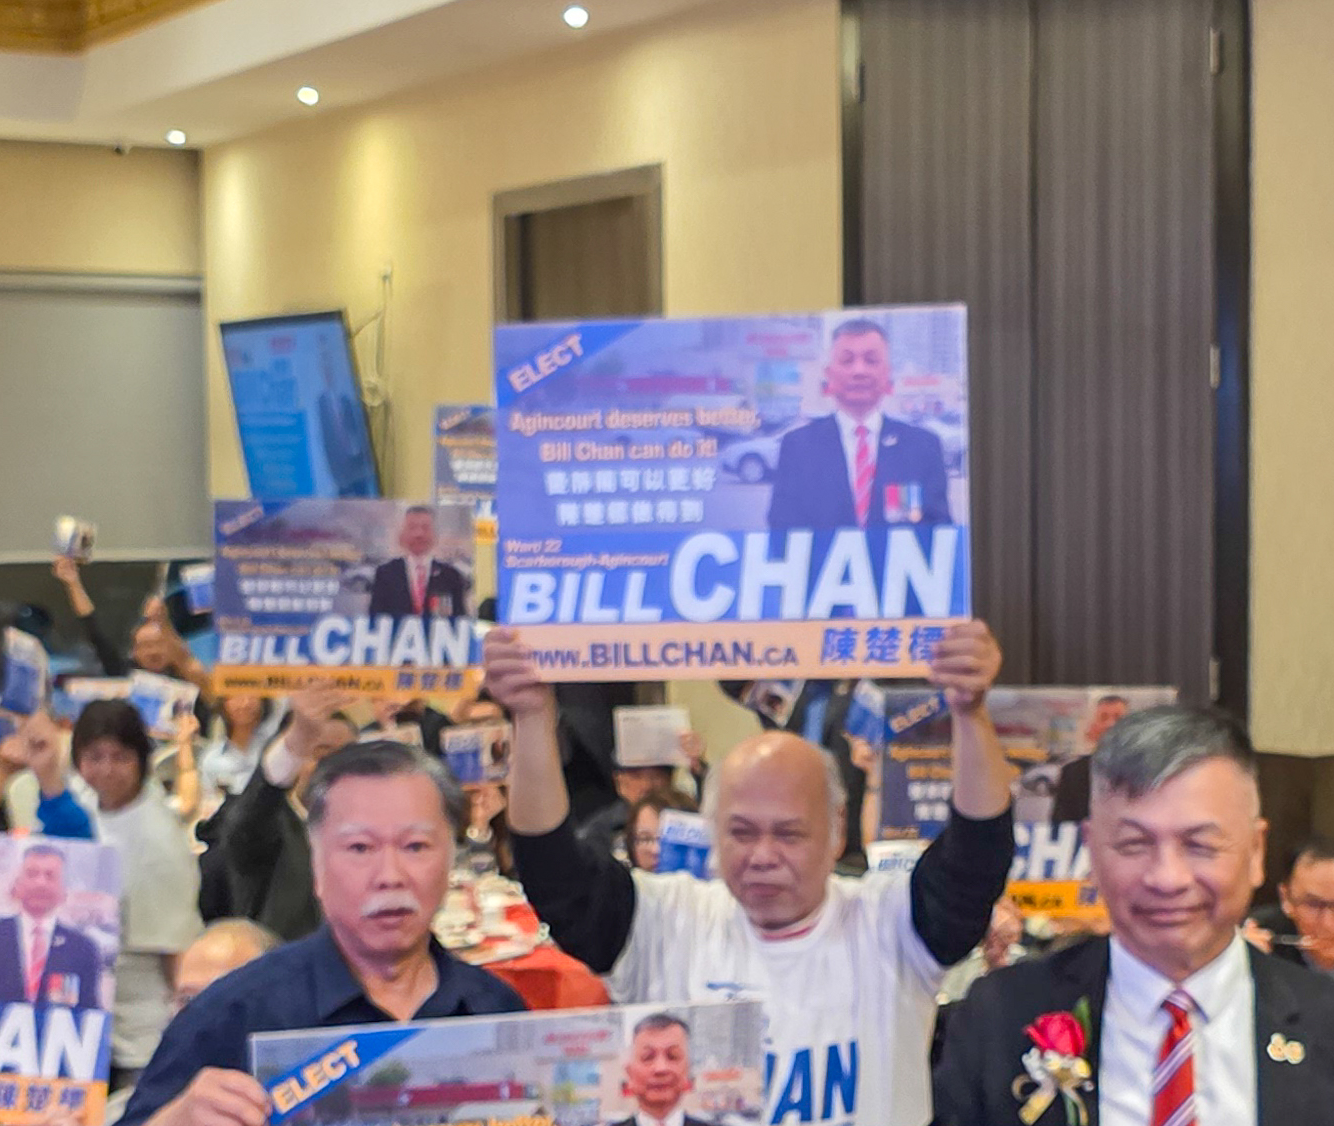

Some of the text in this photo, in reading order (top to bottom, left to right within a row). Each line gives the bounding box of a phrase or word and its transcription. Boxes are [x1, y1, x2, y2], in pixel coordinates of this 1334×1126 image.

[508, 334, 585, 393] ELECT
[510, 410, 602, 436] Agincourt
[606, 410, 692, 428] deserves
[540, 441, 571, 462] Bill
[575, 441, 624, 461] Chan
[628, 443, 664, 460] can
[668, 439, 693, 458] do
[510, 527, 956, 623] BILL CHAN
[221, 614, 470, 667] BILL CHAN
[272, 1040, 361, 1115] ELECT
[765, 1041, 858, 1126] AN
